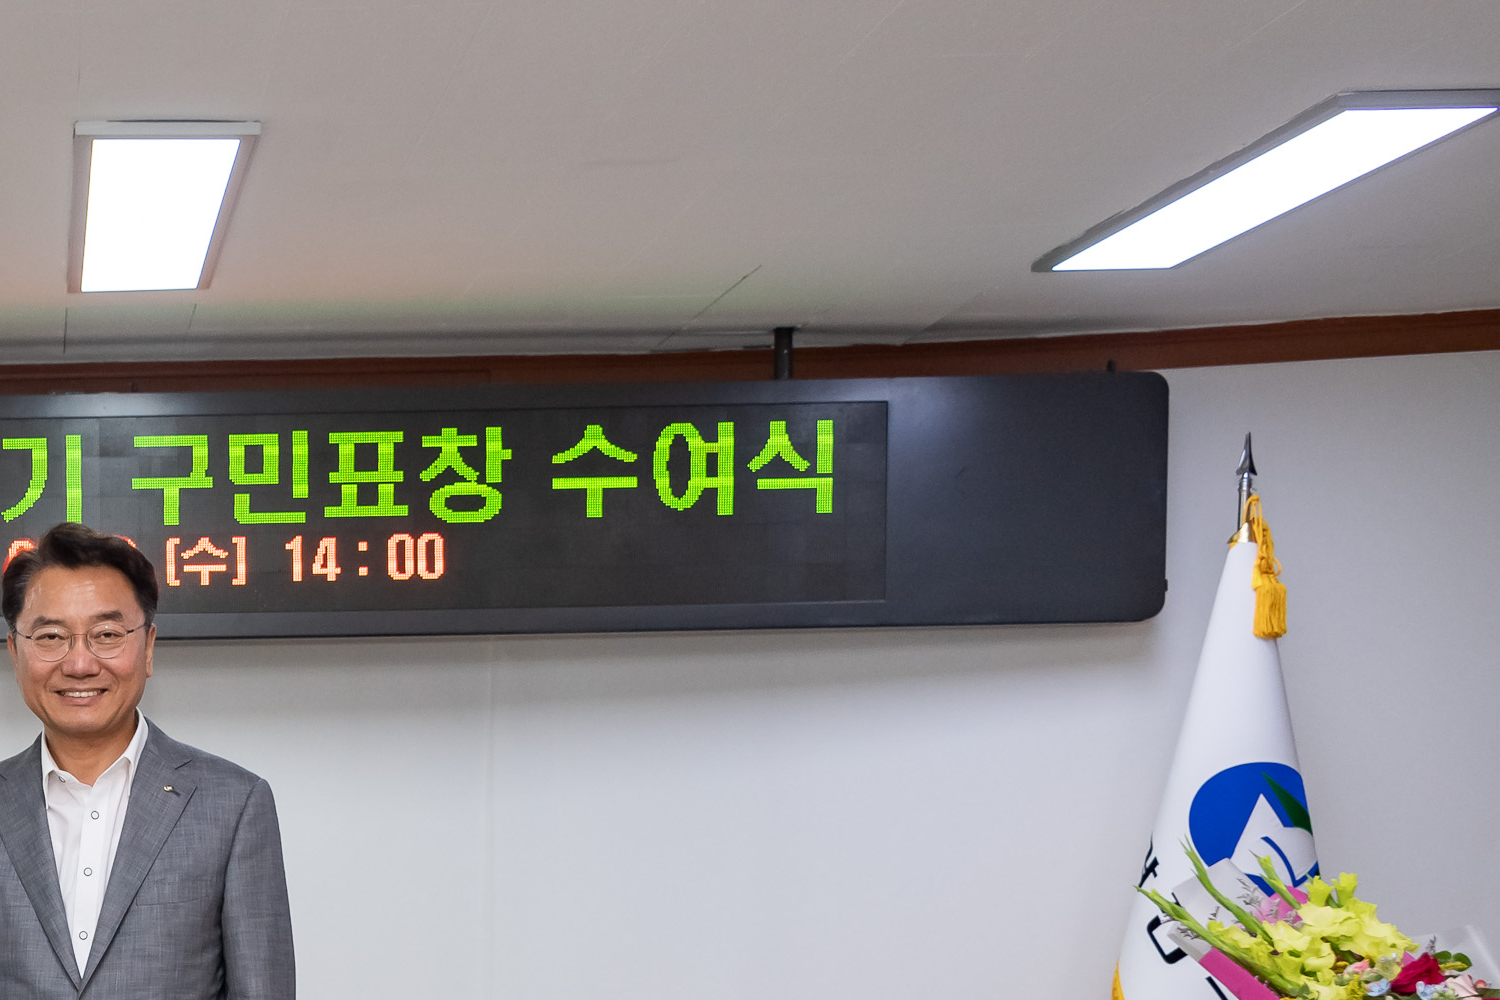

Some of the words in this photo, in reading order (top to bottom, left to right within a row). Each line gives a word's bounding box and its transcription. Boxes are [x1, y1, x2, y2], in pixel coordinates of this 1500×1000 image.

[131, 426, 513, 526] 구민표창
[551, 419, 835, 518] 수여식
[165, 534, 248, 586] [수]
